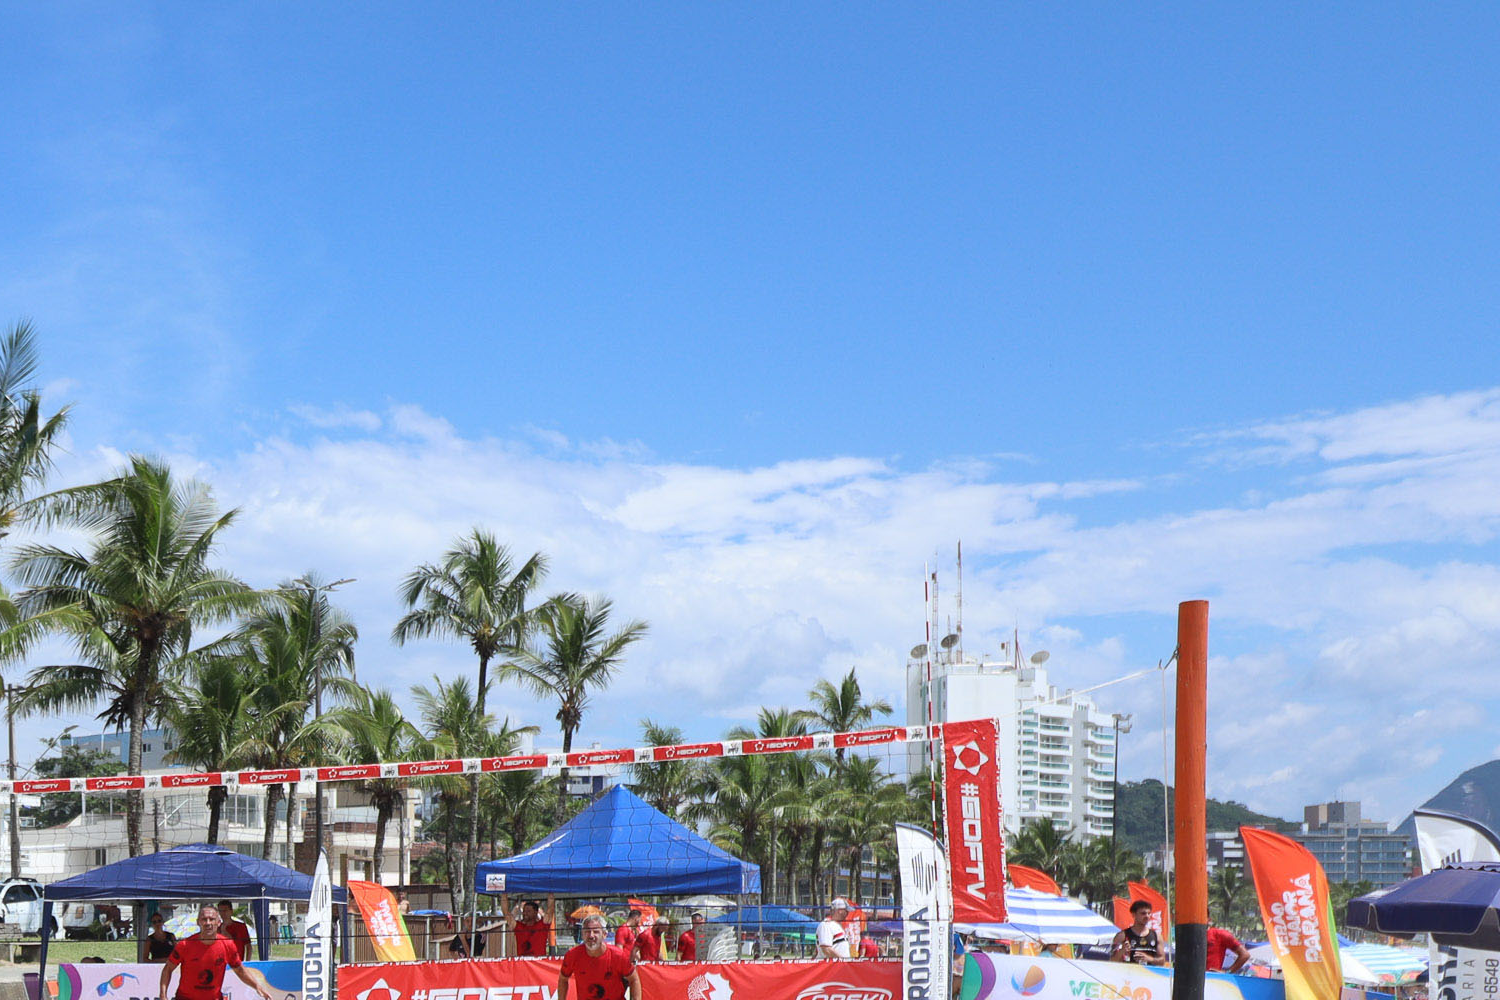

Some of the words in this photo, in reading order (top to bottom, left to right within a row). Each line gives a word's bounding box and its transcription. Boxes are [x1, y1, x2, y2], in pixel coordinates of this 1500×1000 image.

[1268, 902, 1290, 956] VERÃO
[1283, 890, 1302, 947] MAIOR
[1290, 873, 1323, 963] PARANÁ
